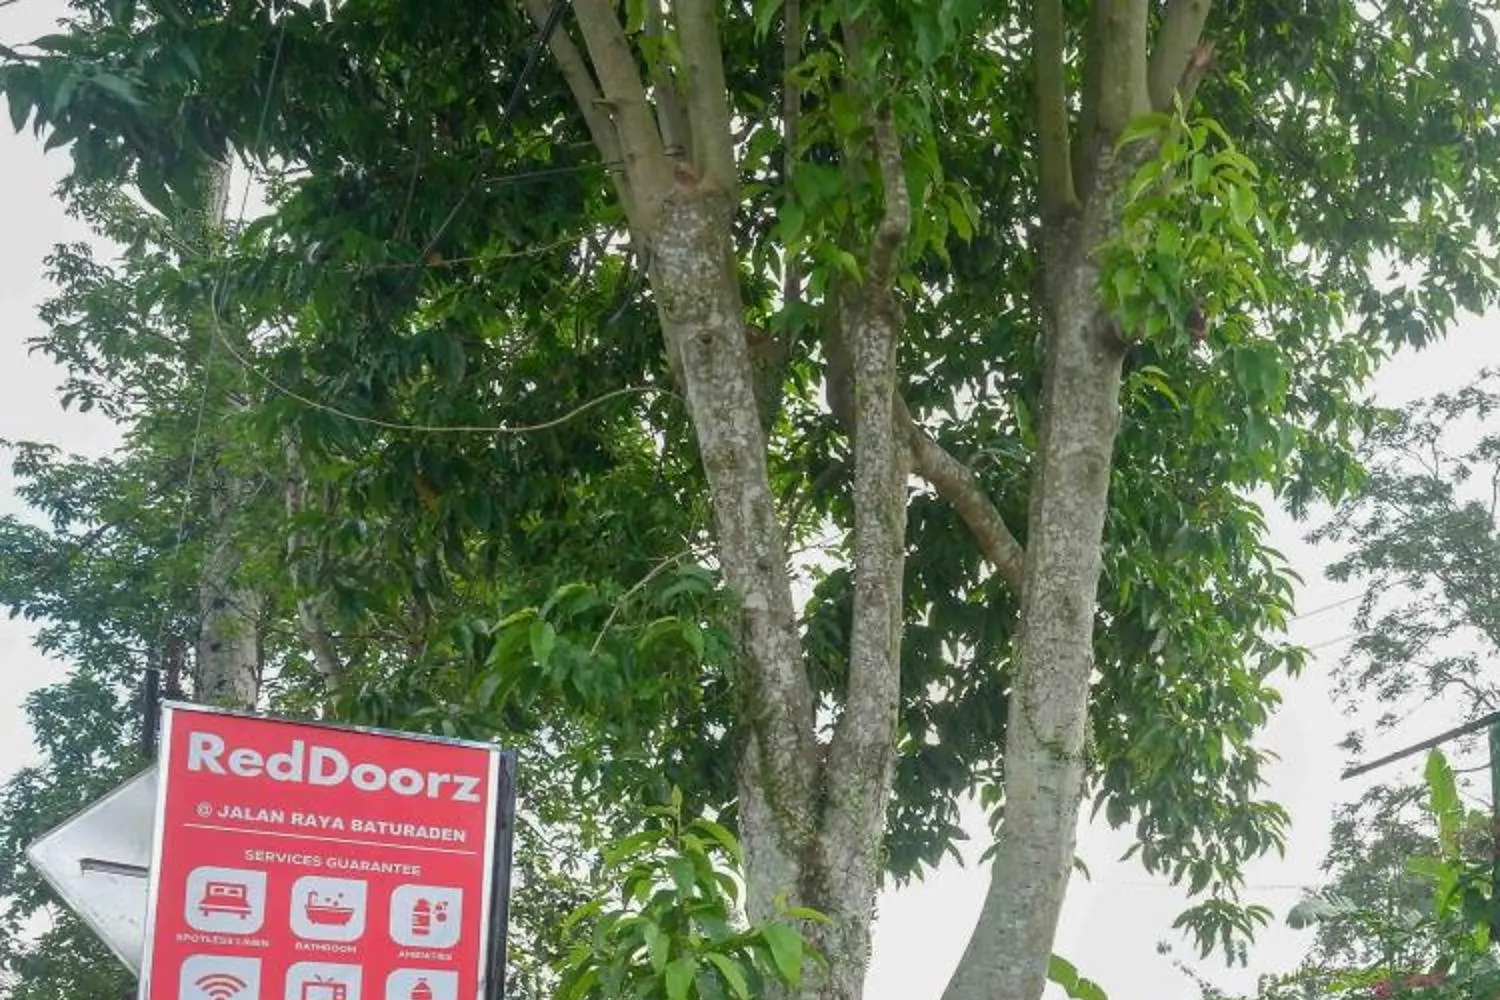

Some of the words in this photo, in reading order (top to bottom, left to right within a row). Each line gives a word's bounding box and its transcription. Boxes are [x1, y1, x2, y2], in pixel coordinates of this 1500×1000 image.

[187, 730, 481, 803] RedDoorz
[217, 803, 285, 825] JALAN
[291, 811, 345, 831] RAYA
[351, 818, 467, 843] BATURADEN
[244, 848, 322, 868] SERVICES
[326, 857, 422, 876] GUARANTEE
[295, 942, 357, 954] BATHROOM
